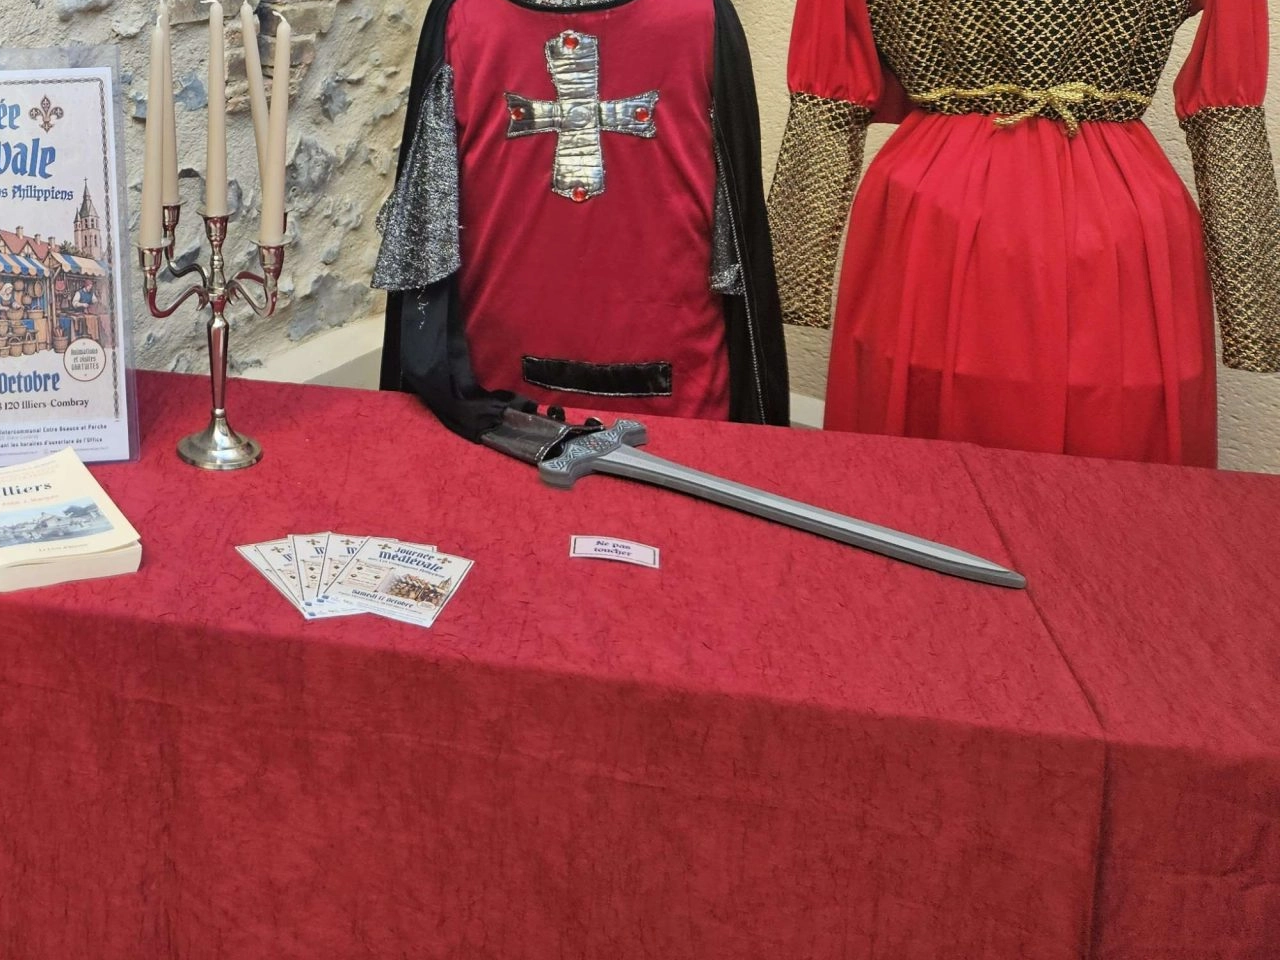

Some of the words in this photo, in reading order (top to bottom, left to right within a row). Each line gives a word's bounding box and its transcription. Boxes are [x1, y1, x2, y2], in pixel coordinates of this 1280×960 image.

[12, 185, 74, 201] Philippiens
[0, 427, 41, 435] Intercommunal
[594, 547, 632, 556] toucher
